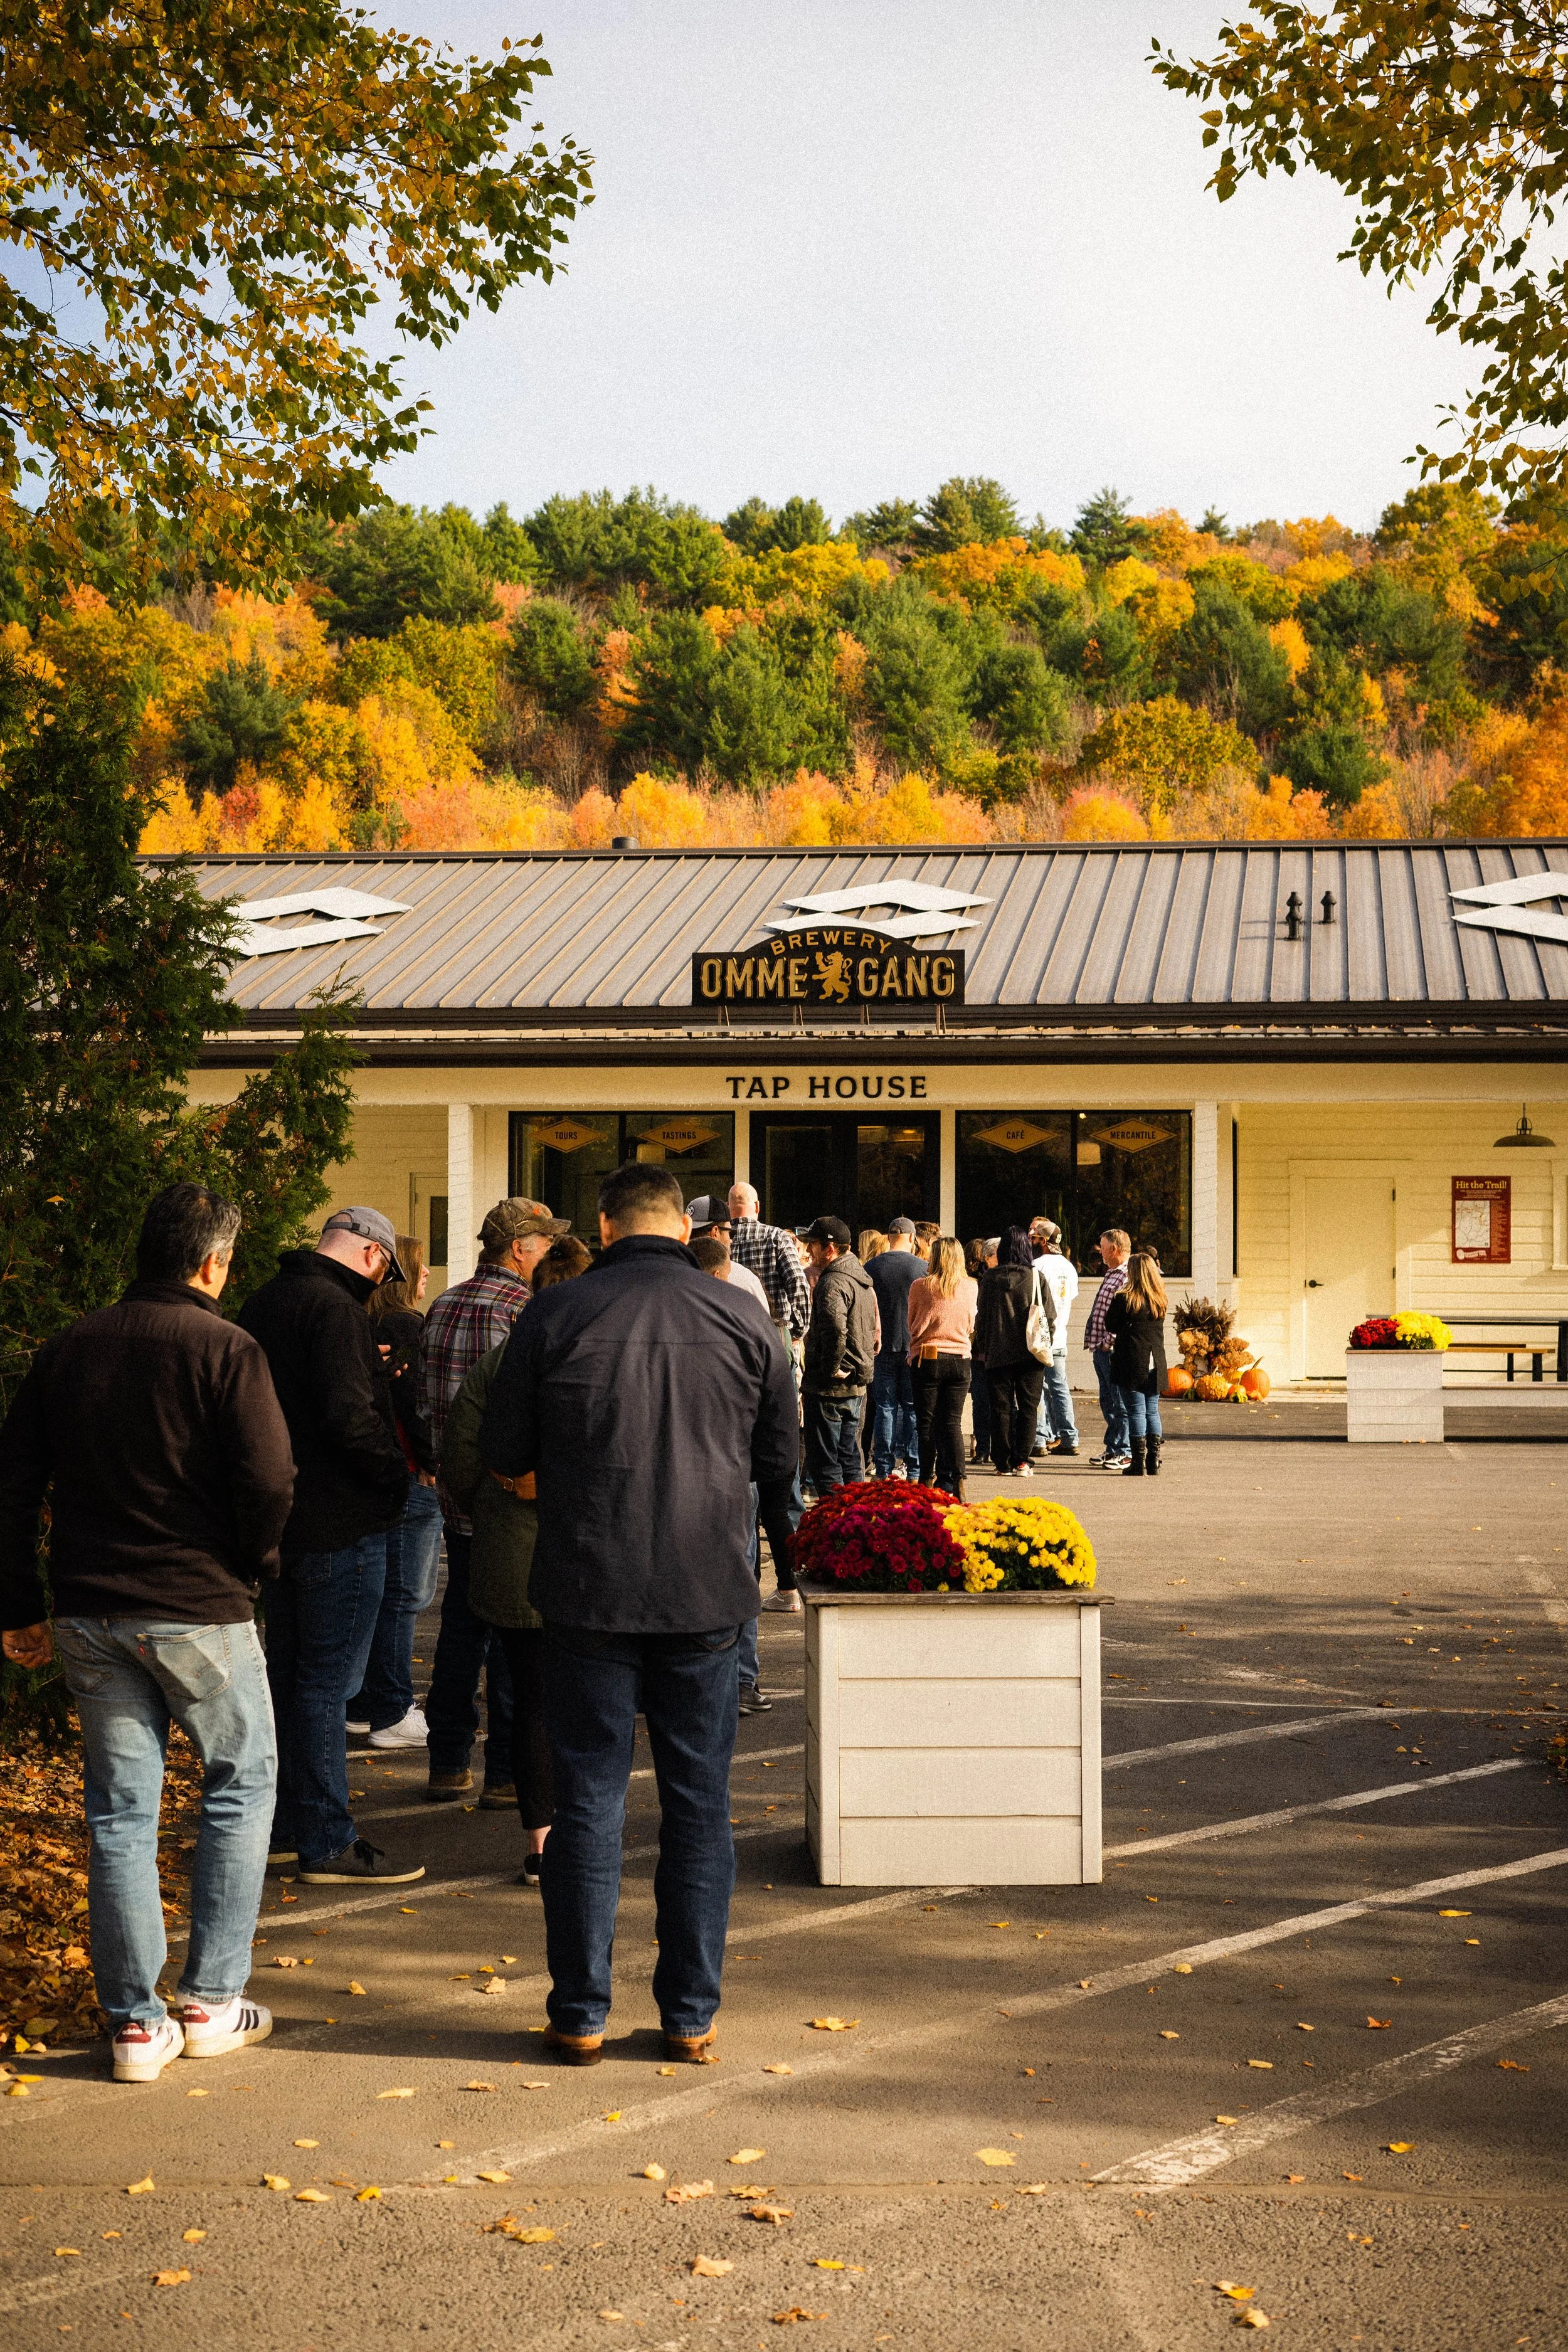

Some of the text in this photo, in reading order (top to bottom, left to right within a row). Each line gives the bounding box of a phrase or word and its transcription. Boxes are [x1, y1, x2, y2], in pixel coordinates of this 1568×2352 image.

[770, 931, 892, 955] BREWERY
[701, 955, 955, 999] OMME GANG
[726, 1076, 927, 1099] TAP HOUSE
[555, 1131, 578, 1140] TOURS
[662, 1131, 696, 1140] TASTINGS
[1006, 1130, 1024, 1139] CAFÉ
[1110, 1130, 1155, 1139] MERCANTILE
[1471, 1180, 1484, 1189] the
[1485, 1180, 1507, 1189] Trail!
